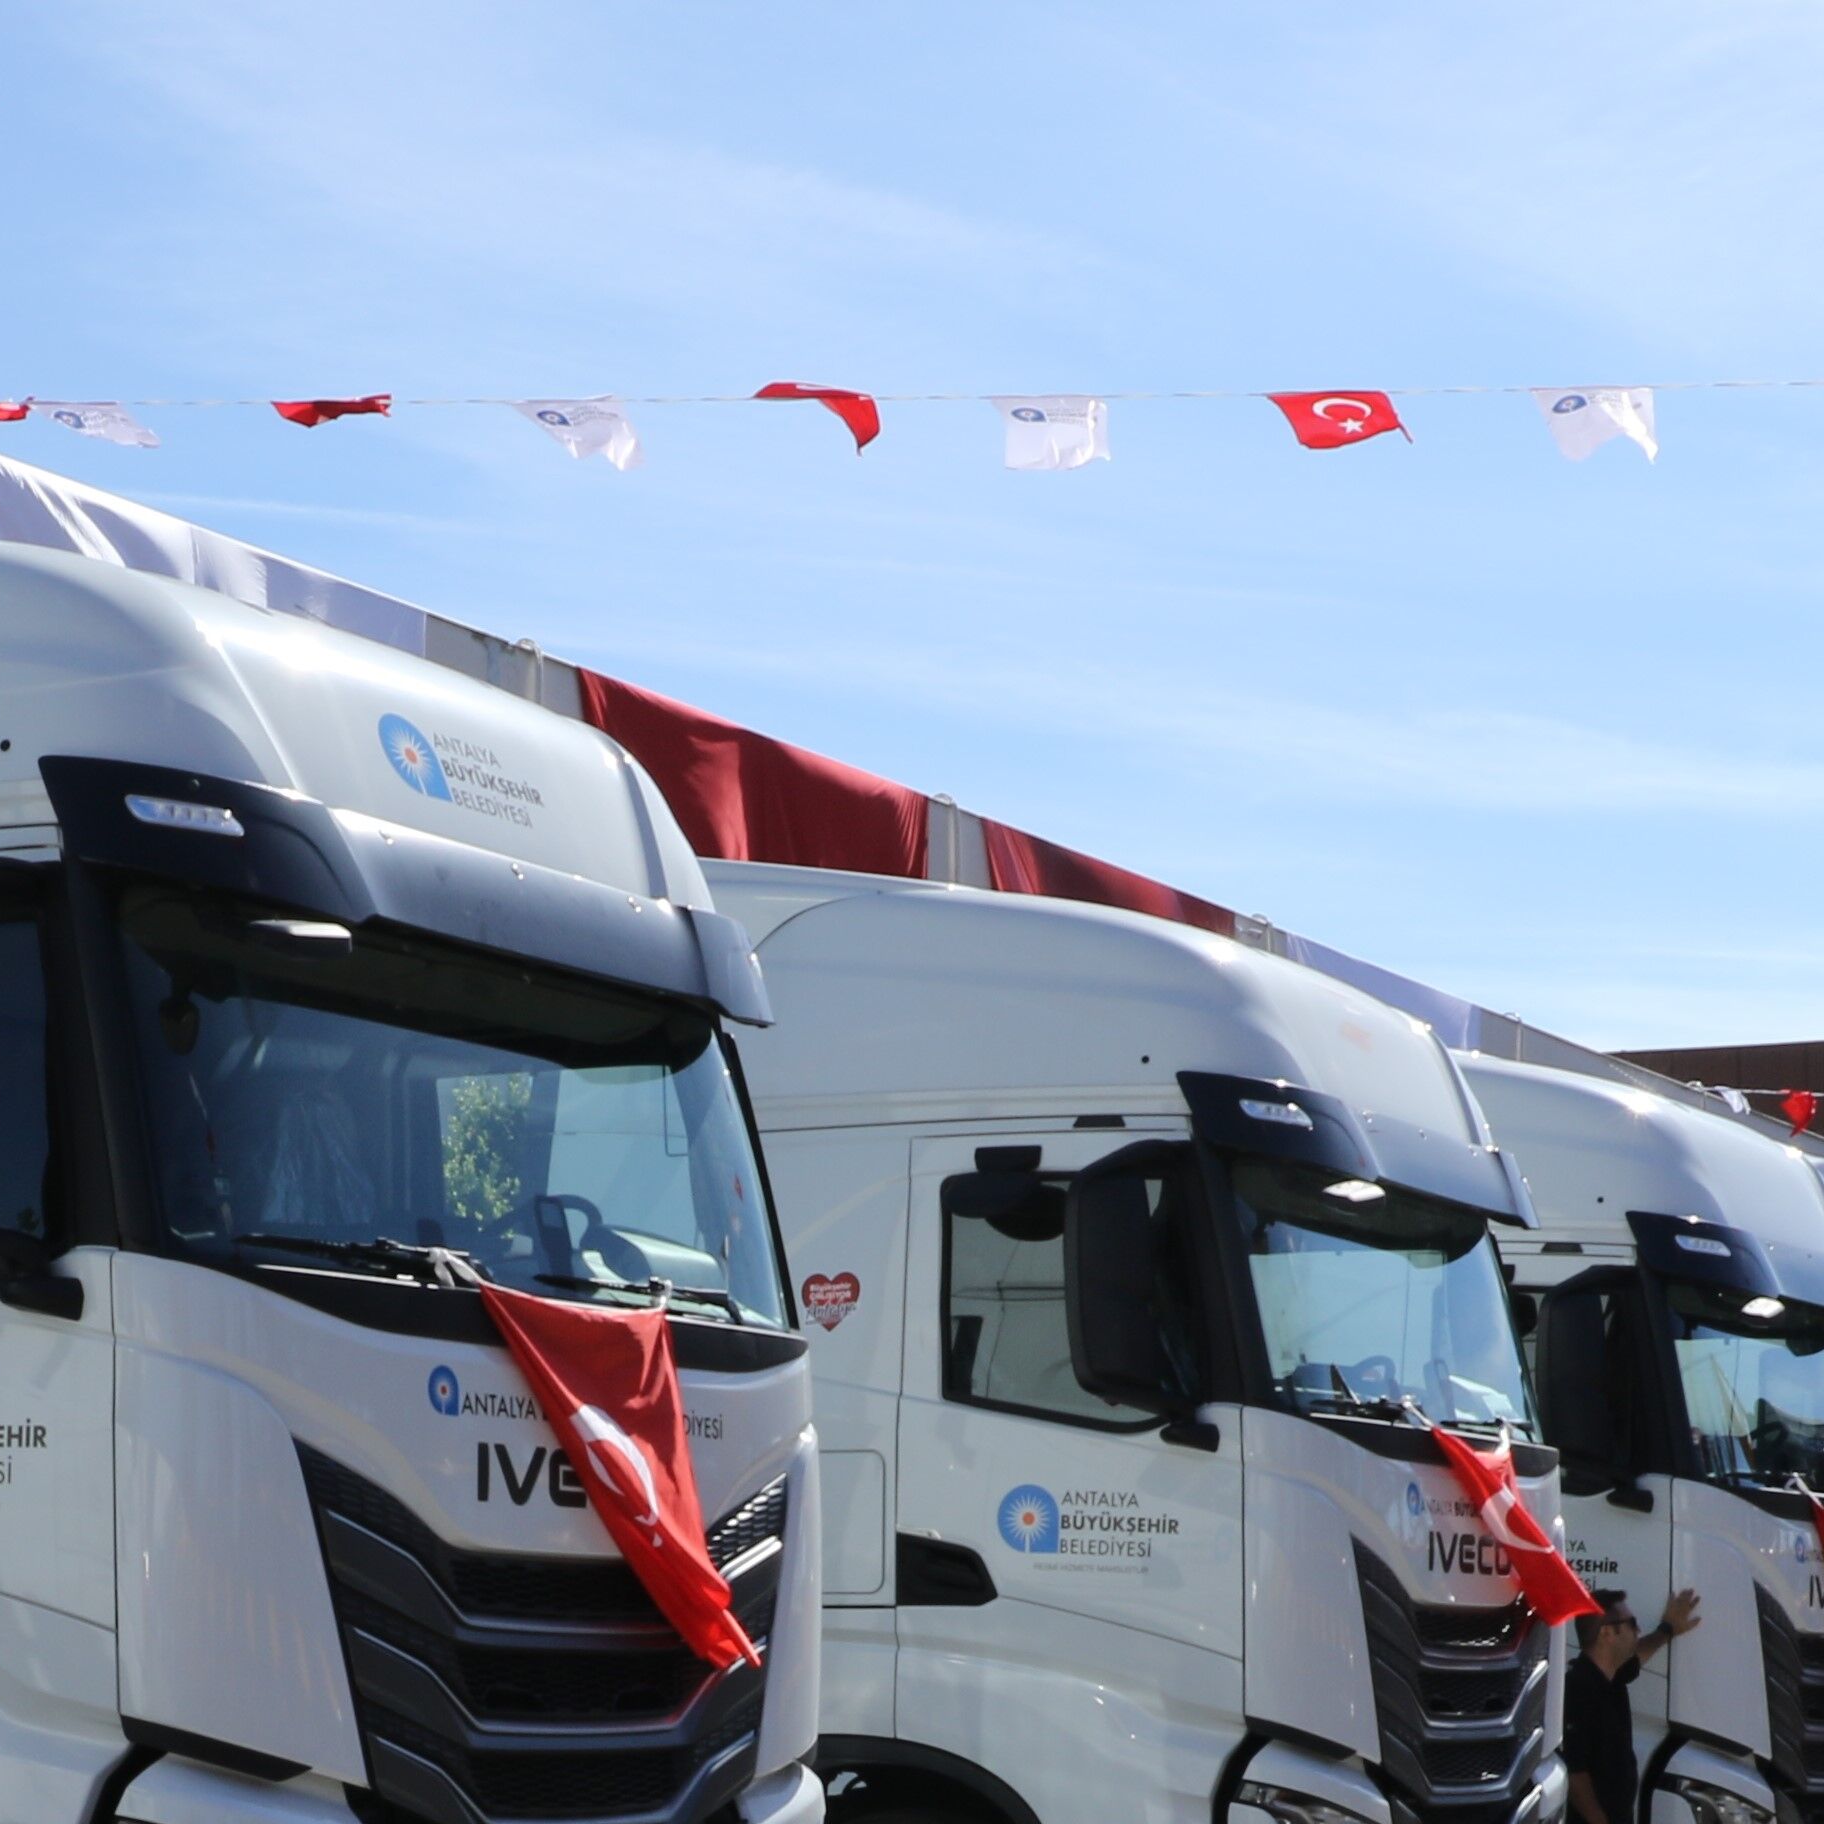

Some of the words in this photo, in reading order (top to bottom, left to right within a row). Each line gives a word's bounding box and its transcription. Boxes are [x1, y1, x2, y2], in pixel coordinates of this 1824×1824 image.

[433, 732, 502, 769] ANTALYA
[441, 757, 545, 808] BÜYÜKŞEHİR
[451, 786, 533, 829] BELEDİYESİ
[461, 1391, 538, 1421] ANTALYA
[682, 1410, 723, 1441] DİYESİ
[477, 1441, 588, 1508] IVE
[1061, 1490, 1139, 1508] ANTALYA
[1060, 1511, 1179, 1536] BÜYÜKŞEHİR
[1060, 1537, 1151, 1557] BELEDİYESİ
[1566, 1556, 1619, 1575] KŞEHİR
